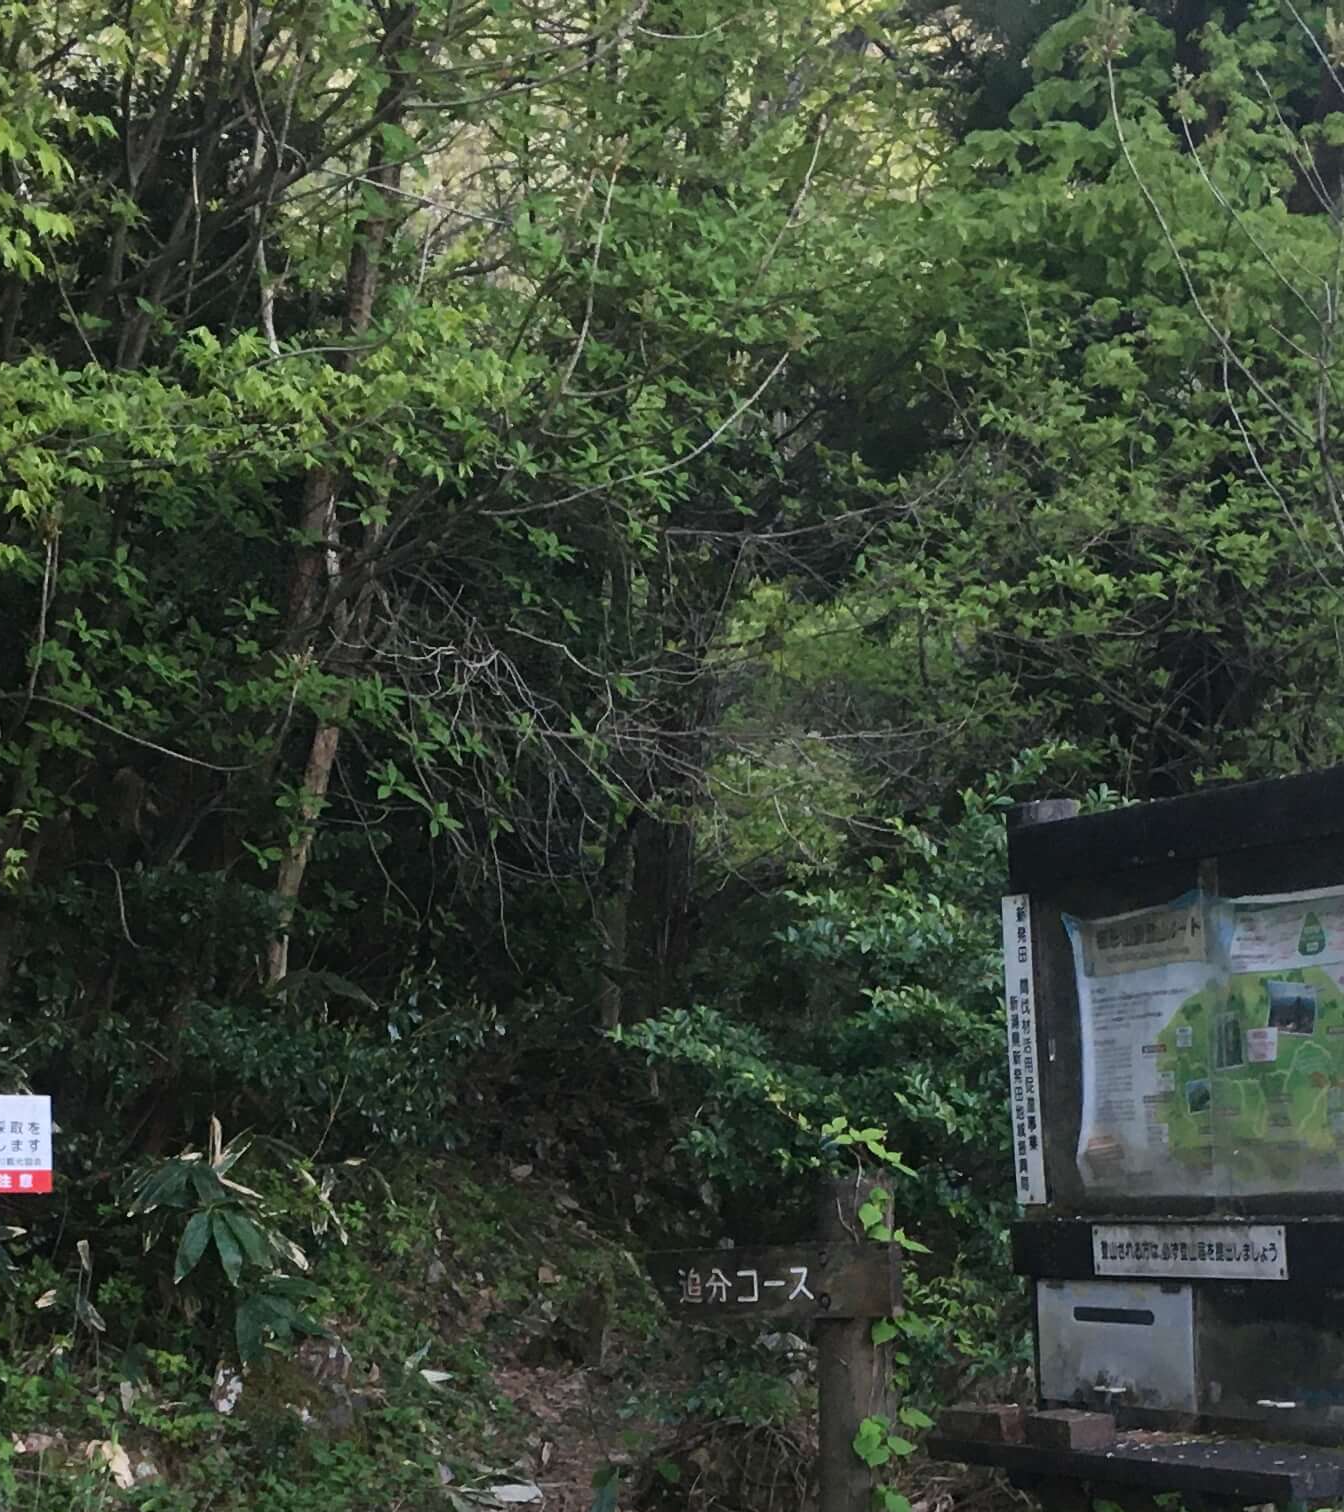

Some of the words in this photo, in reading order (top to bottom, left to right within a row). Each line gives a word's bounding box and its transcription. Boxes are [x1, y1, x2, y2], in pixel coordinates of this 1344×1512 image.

[678, 1267, 815, 1304] 追分コース
